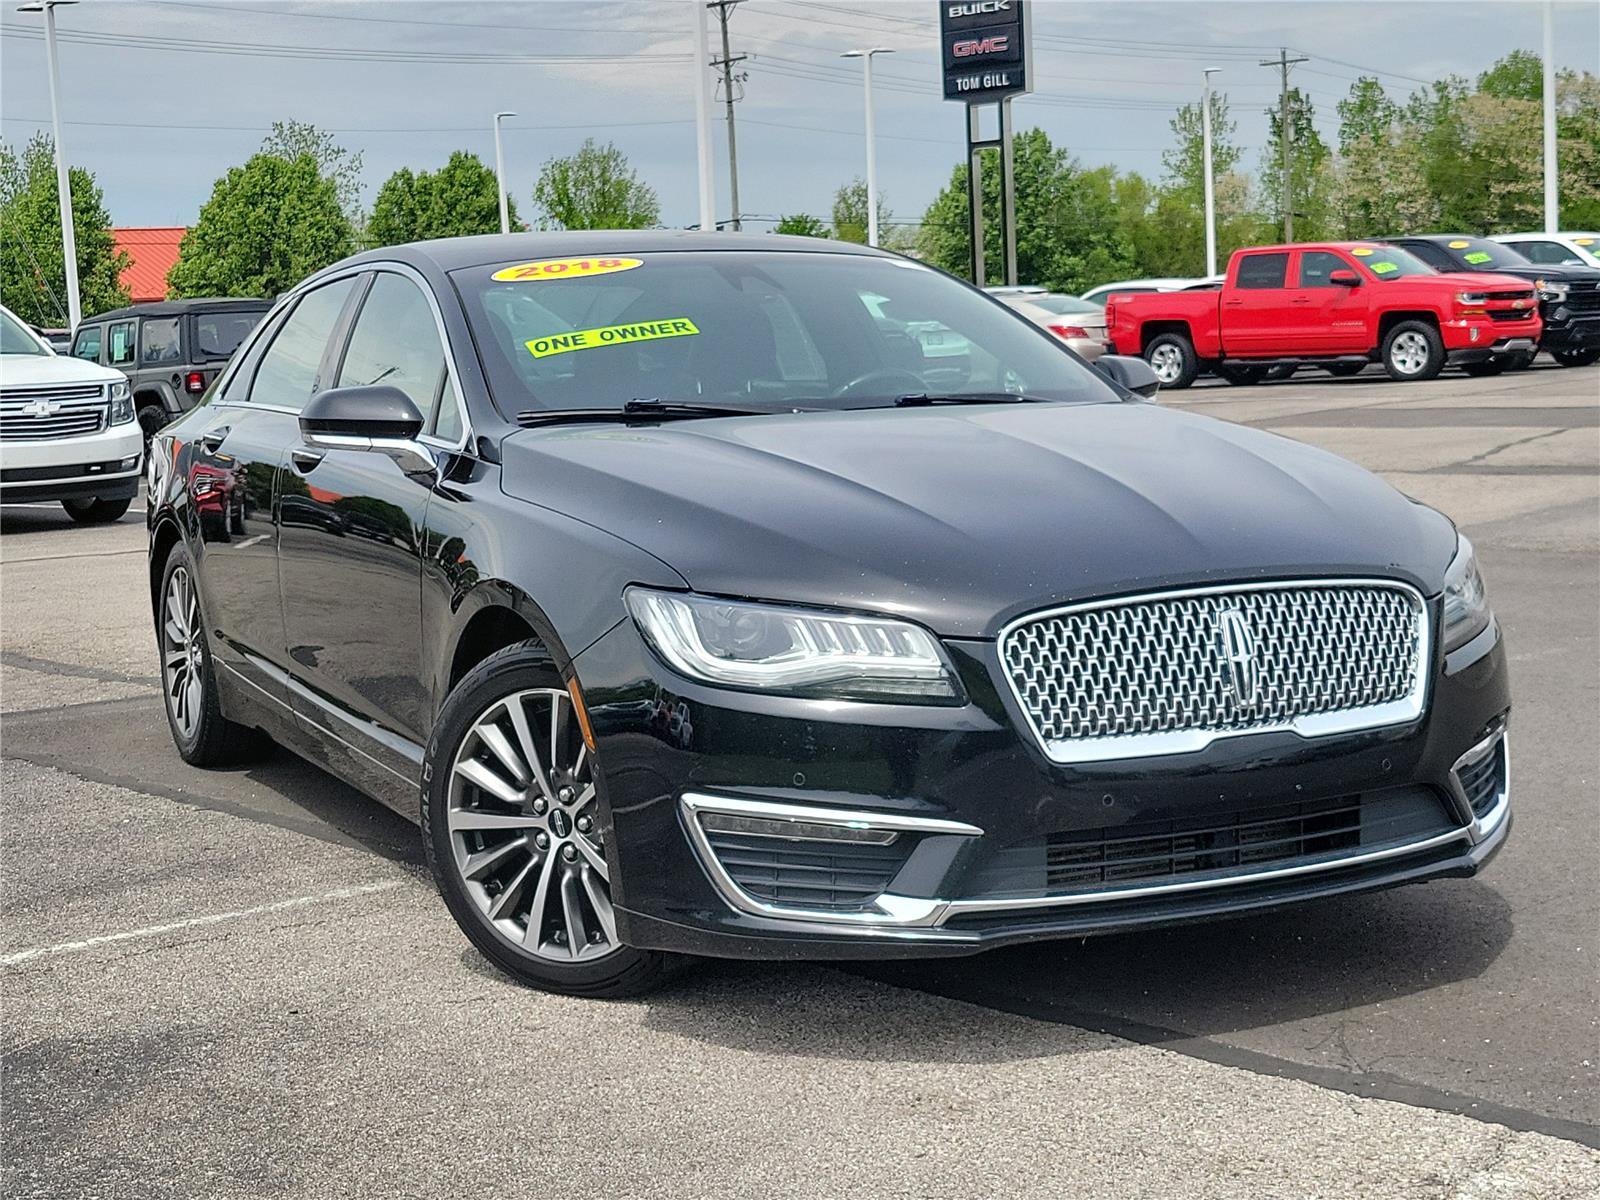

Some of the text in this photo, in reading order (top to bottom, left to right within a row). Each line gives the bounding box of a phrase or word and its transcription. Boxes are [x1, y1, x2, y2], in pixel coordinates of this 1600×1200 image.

[949, 0, 1010, 17] BUICK
[953, 37, 1008, 57] GMC
[956, 73, 1010, 91] TOM GILL
[514, 259, 622, 278] 2018
[534, 321, 693, 353] ONE OWNER
